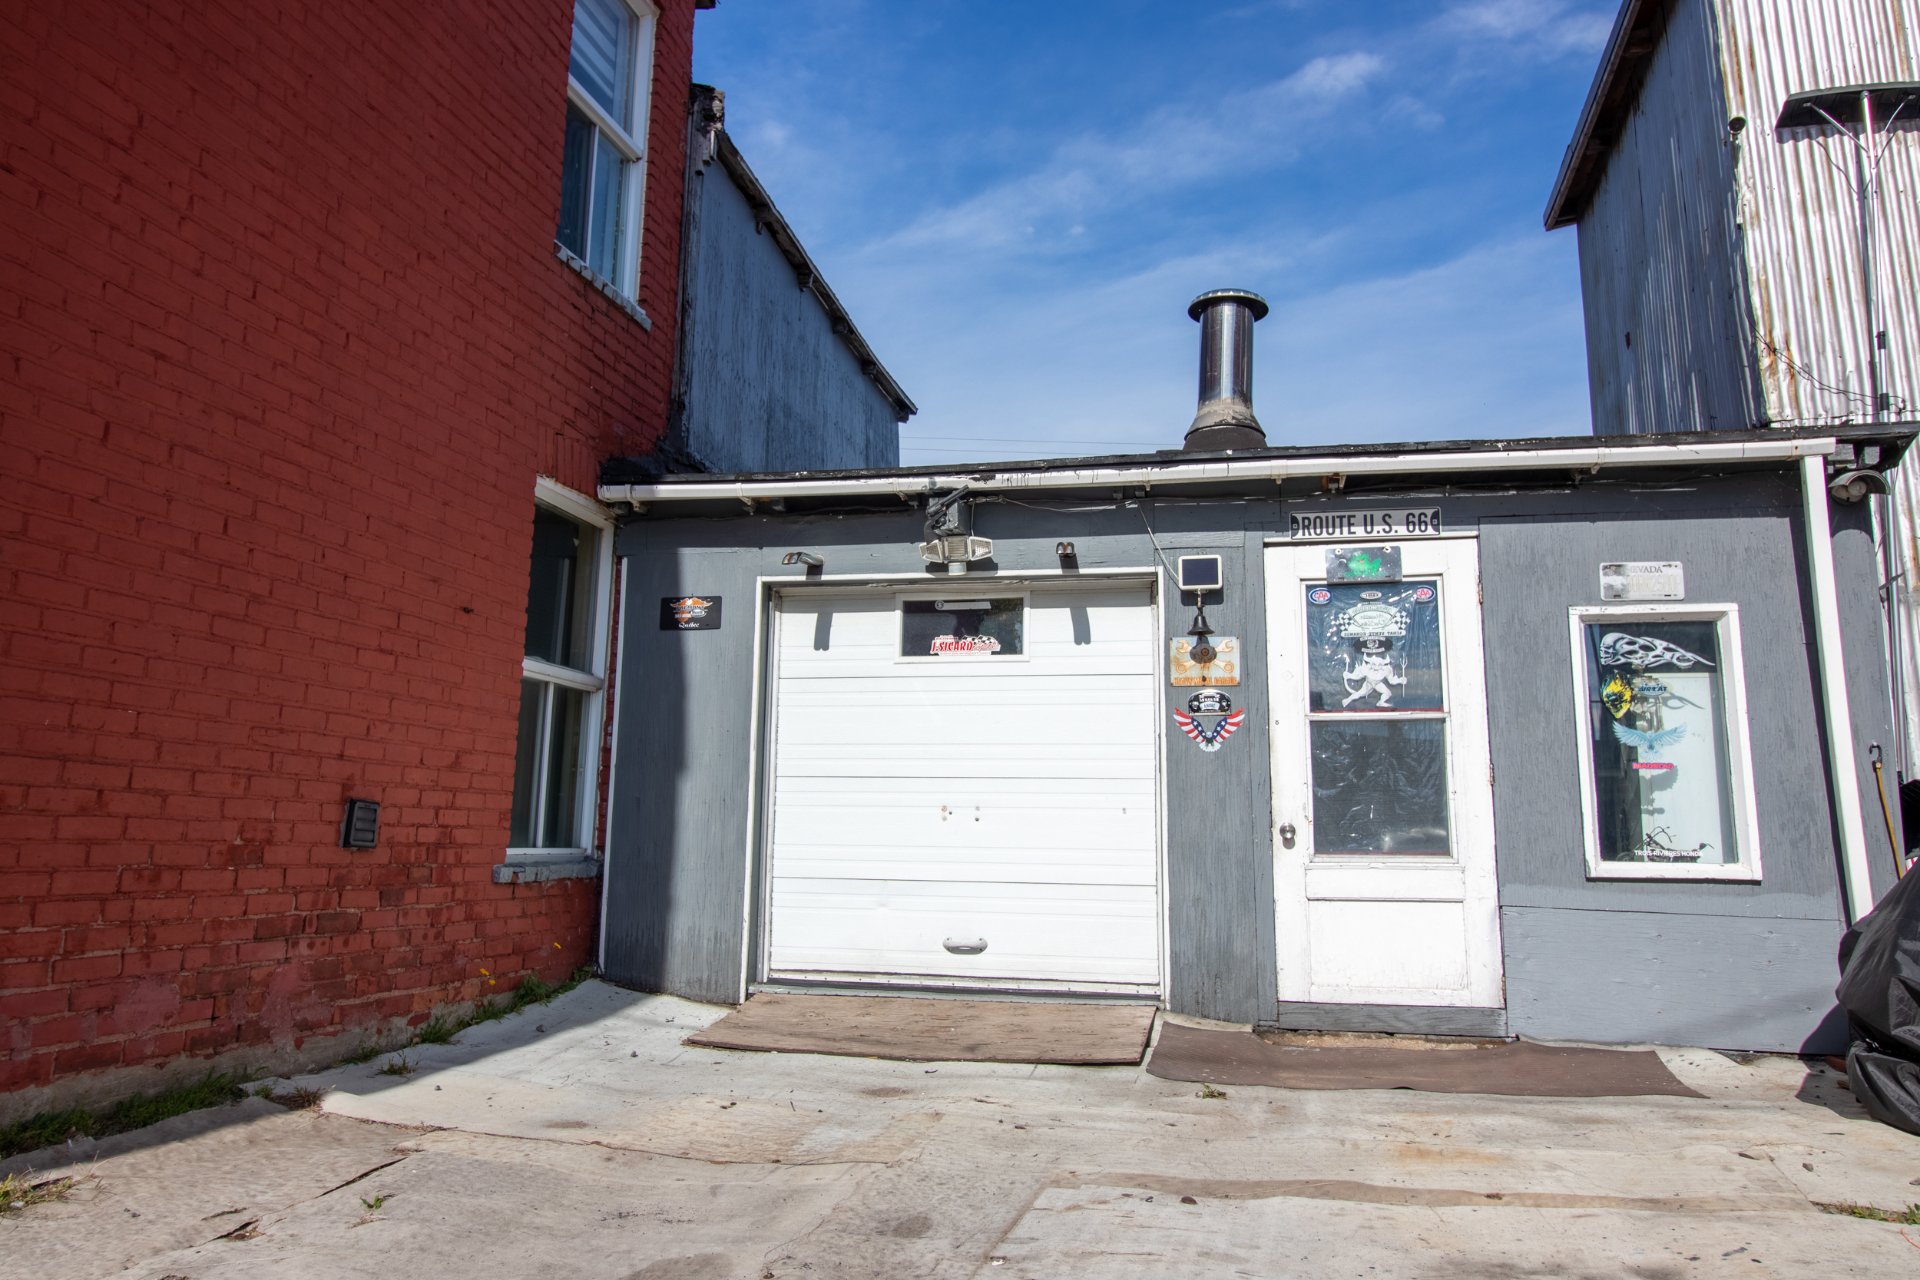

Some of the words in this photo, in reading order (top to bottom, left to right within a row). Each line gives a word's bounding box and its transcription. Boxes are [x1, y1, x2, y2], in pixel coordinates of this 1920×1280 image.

[1301, 514, 1357, 537] ROUTE
[1363, 513, 1398, 535] U.S.
[1405, 512, 1428, 533] 66
[1629, 565, 1663, 574] EVADA
